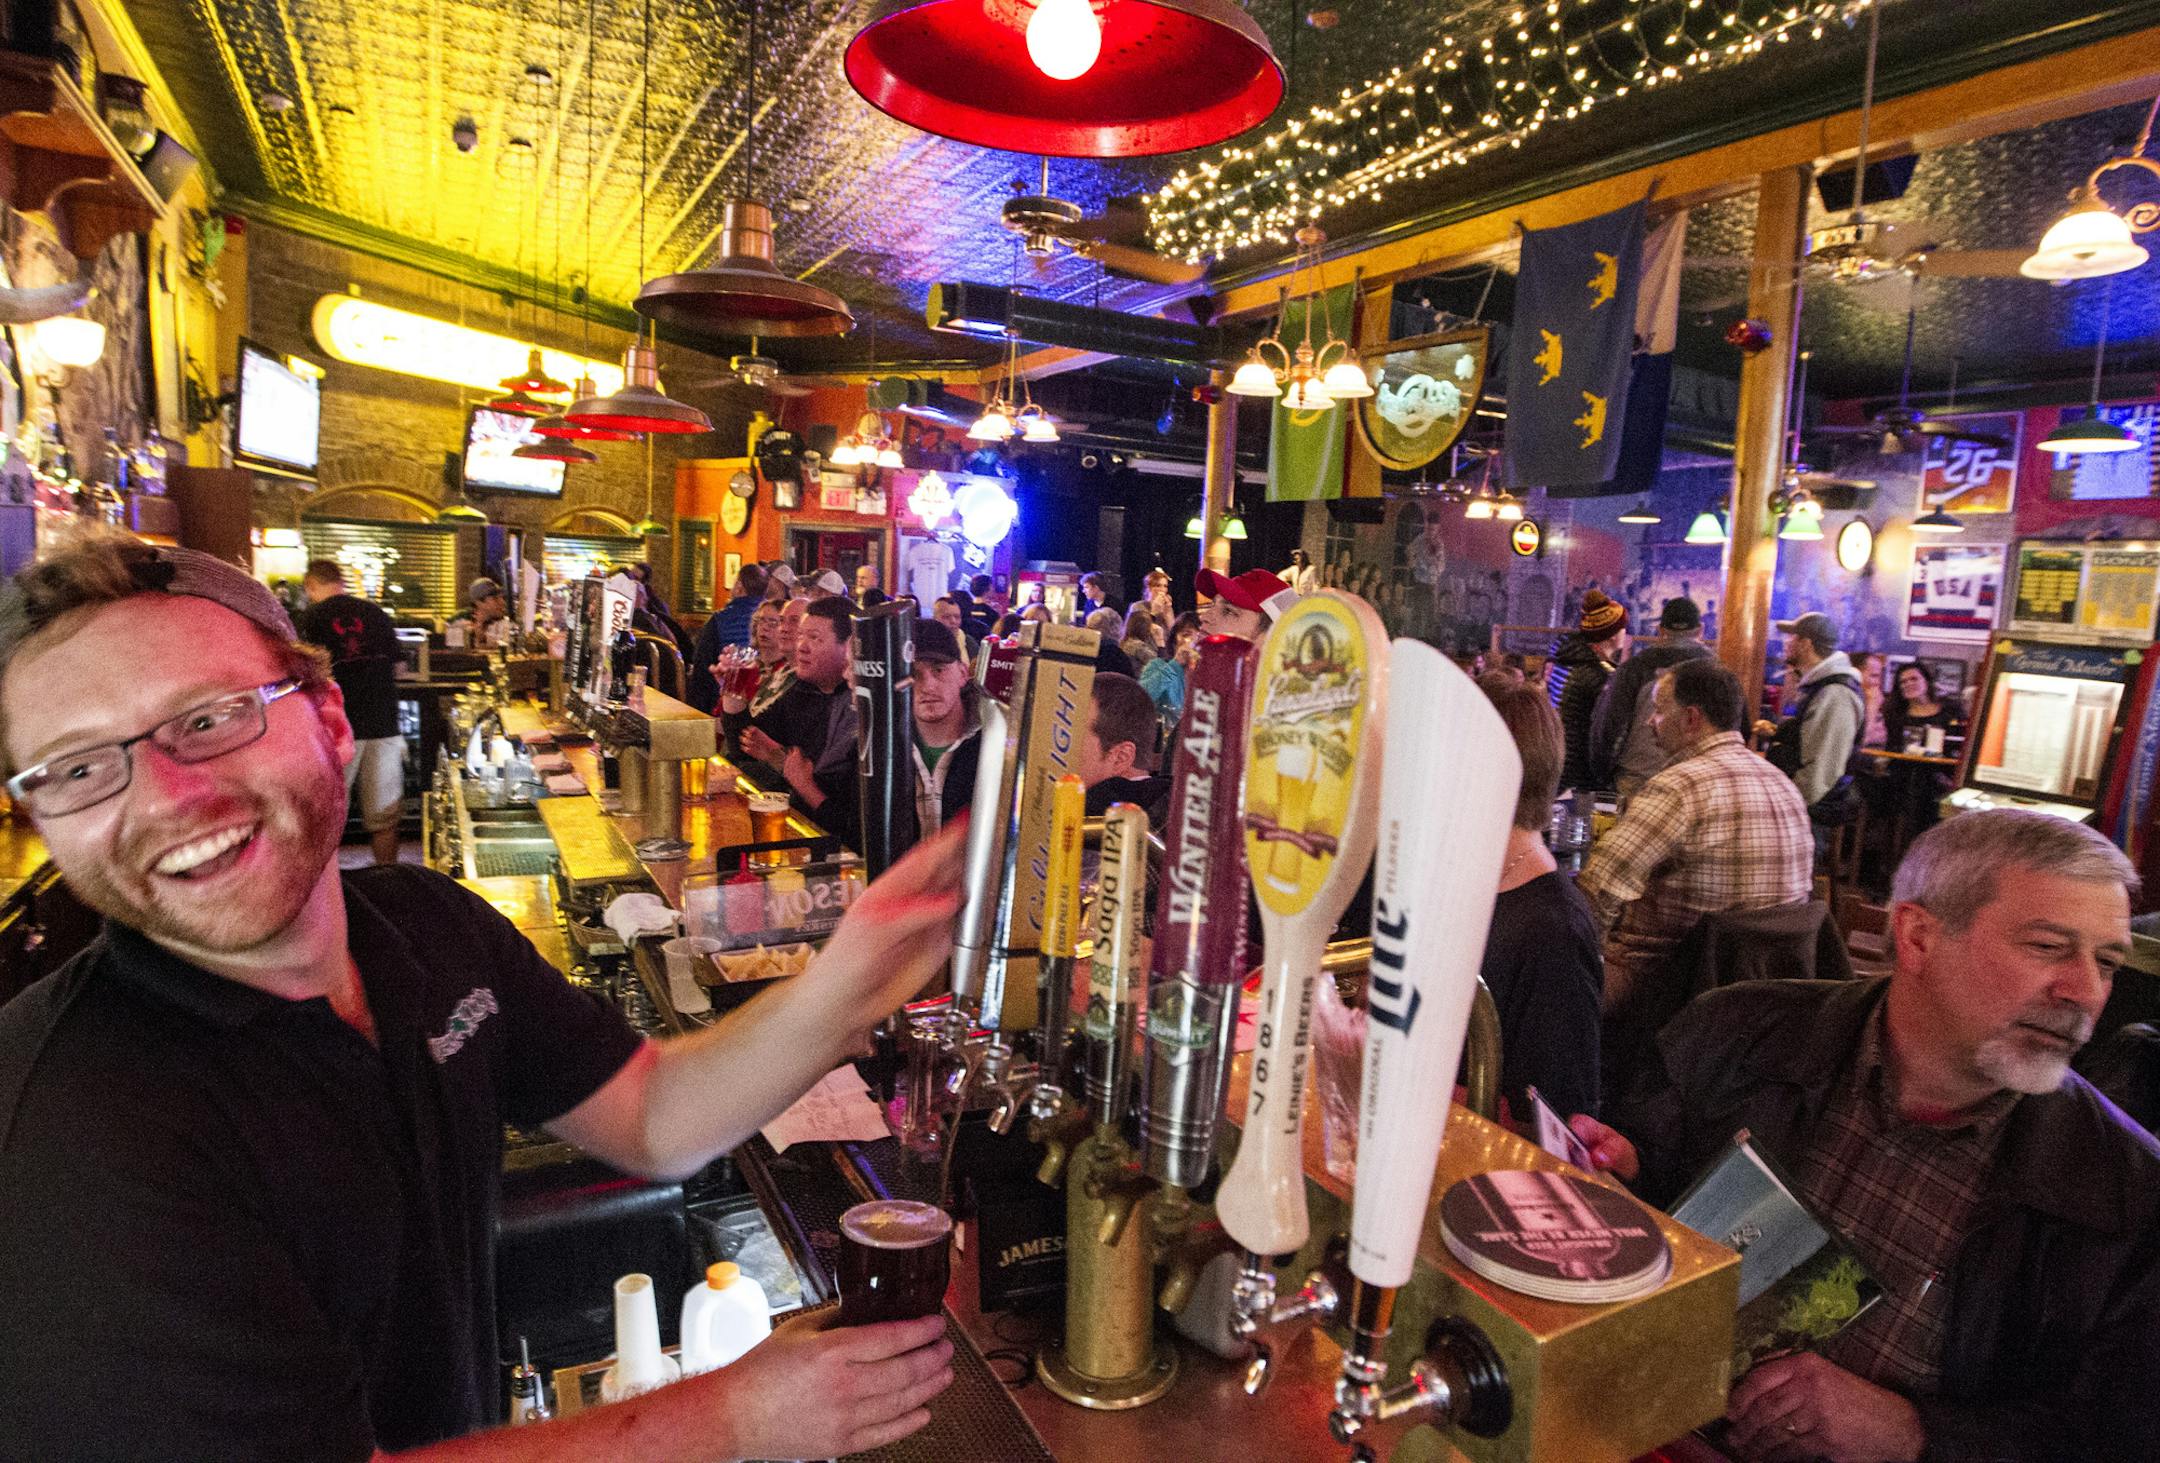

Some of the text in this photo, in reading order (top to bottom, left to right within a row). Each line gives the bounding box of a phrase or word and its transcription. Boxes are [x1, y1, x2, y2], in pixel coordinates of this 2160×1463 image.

[1943, 447, 1998, 486] 26
[1934, 578, 1972, 598] USA
[990, 658, 1016, 671] SMIT
[1168, 687, 1222, 926] WINTER ALE
[1095, 816, 1124, 955] Saga IPA
[1295, 976, 1315, 1047] BEERS
[998, 1236, 1065, 1268] JAMES
